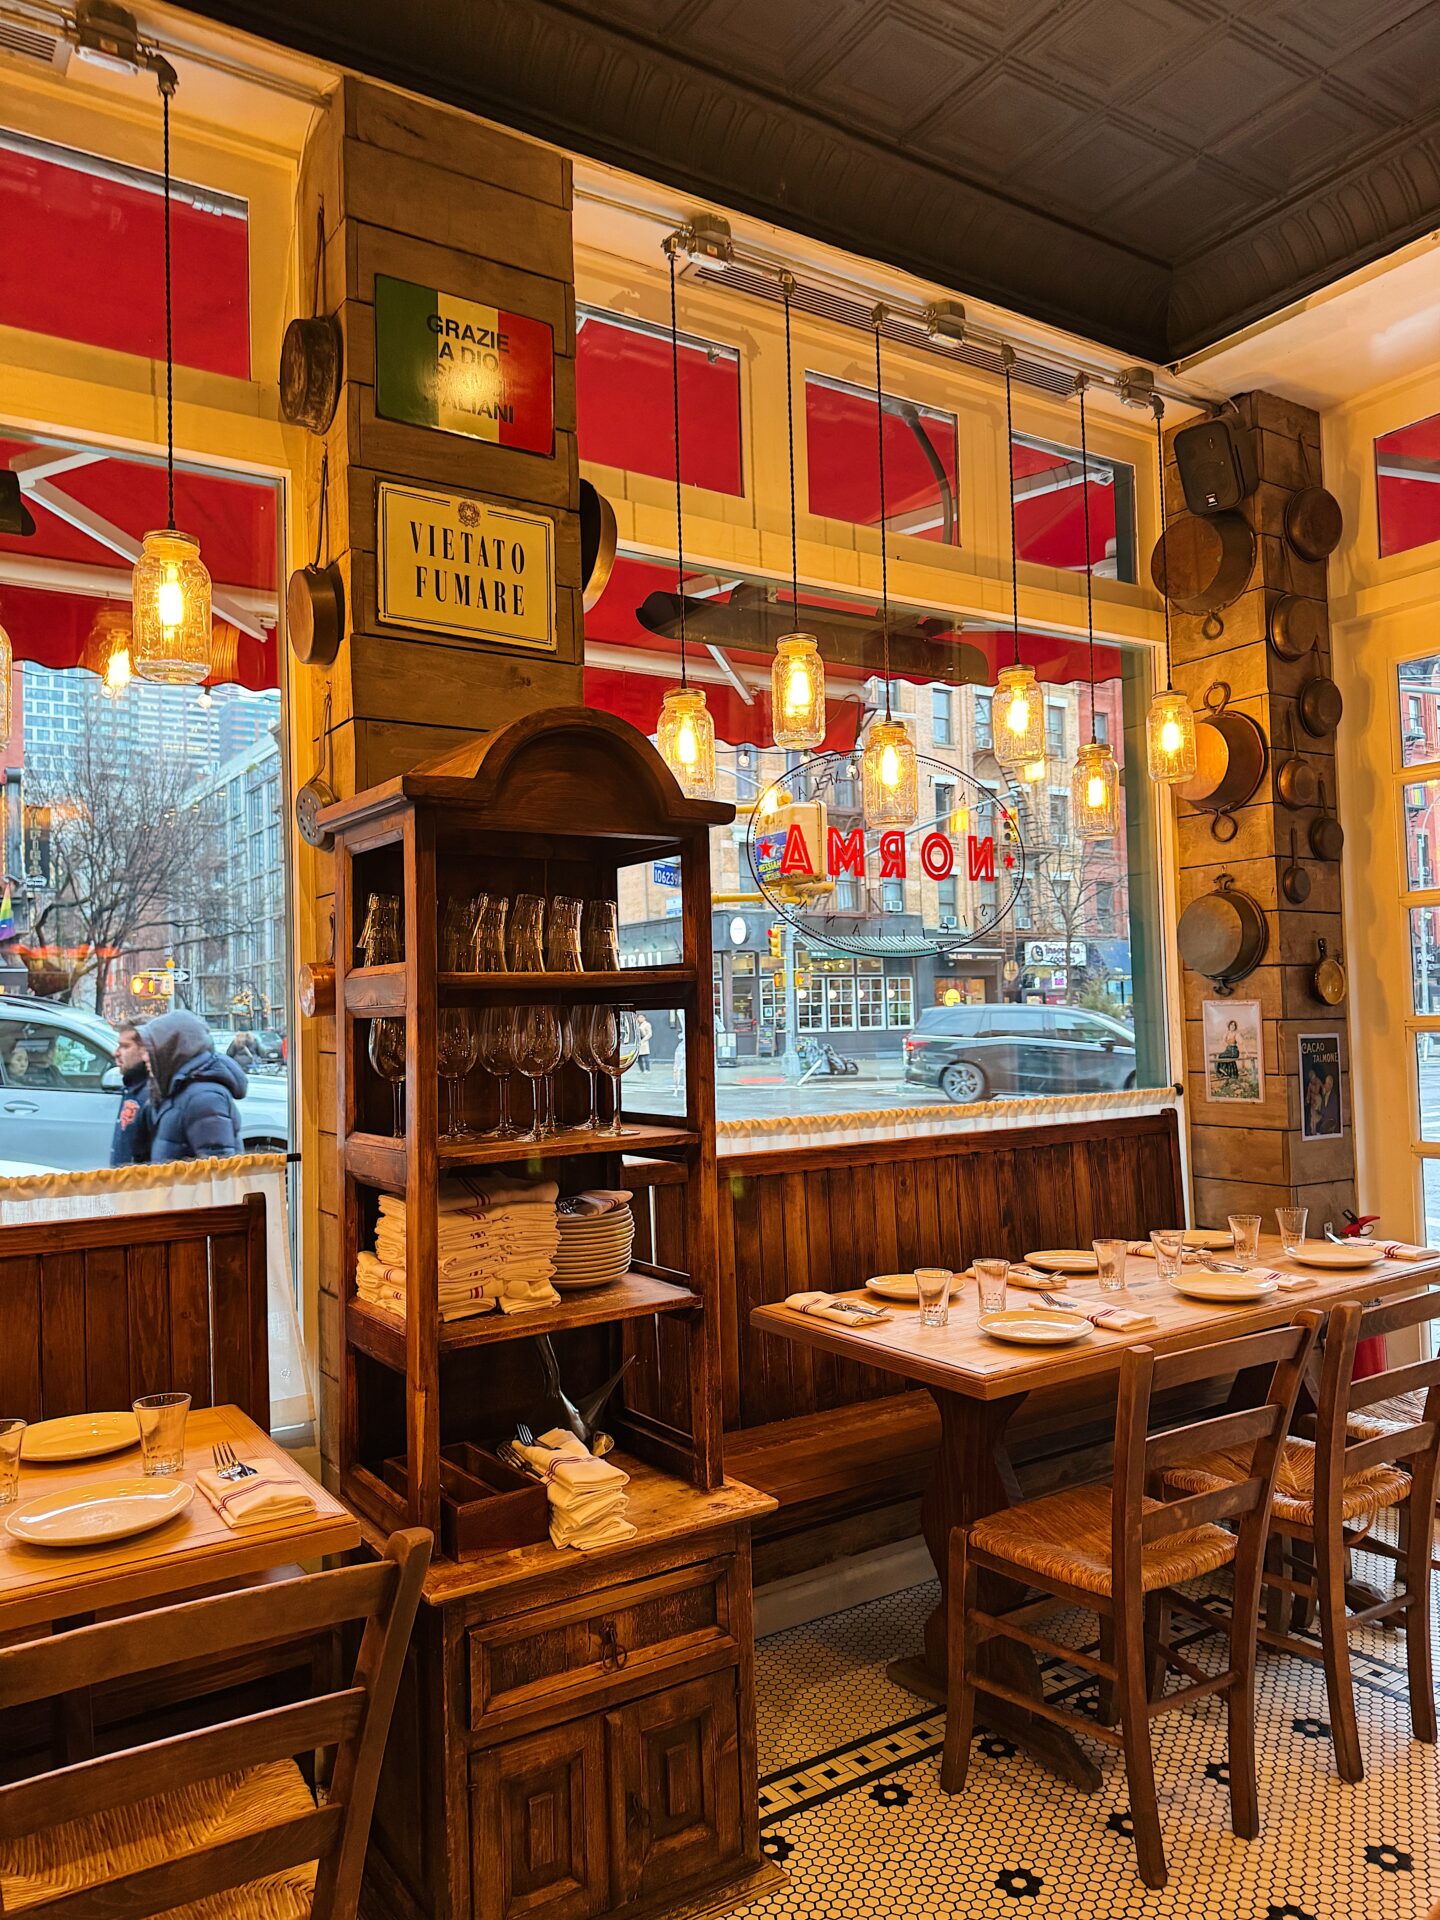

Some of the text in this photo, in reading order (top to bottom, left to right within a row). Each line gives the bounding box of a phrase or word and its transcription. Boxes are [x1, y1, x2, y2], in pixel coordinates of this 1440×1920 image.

[426, 314, 510, 354] GRAZIE
[439, 341, 499, 373] A DIO
[410, 521, 525, 575] VIETATO
[416, 565, 525, 617] FUMARE
[1302, 1042, 1325, 1054] CACAO
[1313, 1052, 1339, 1063] TALMONE
